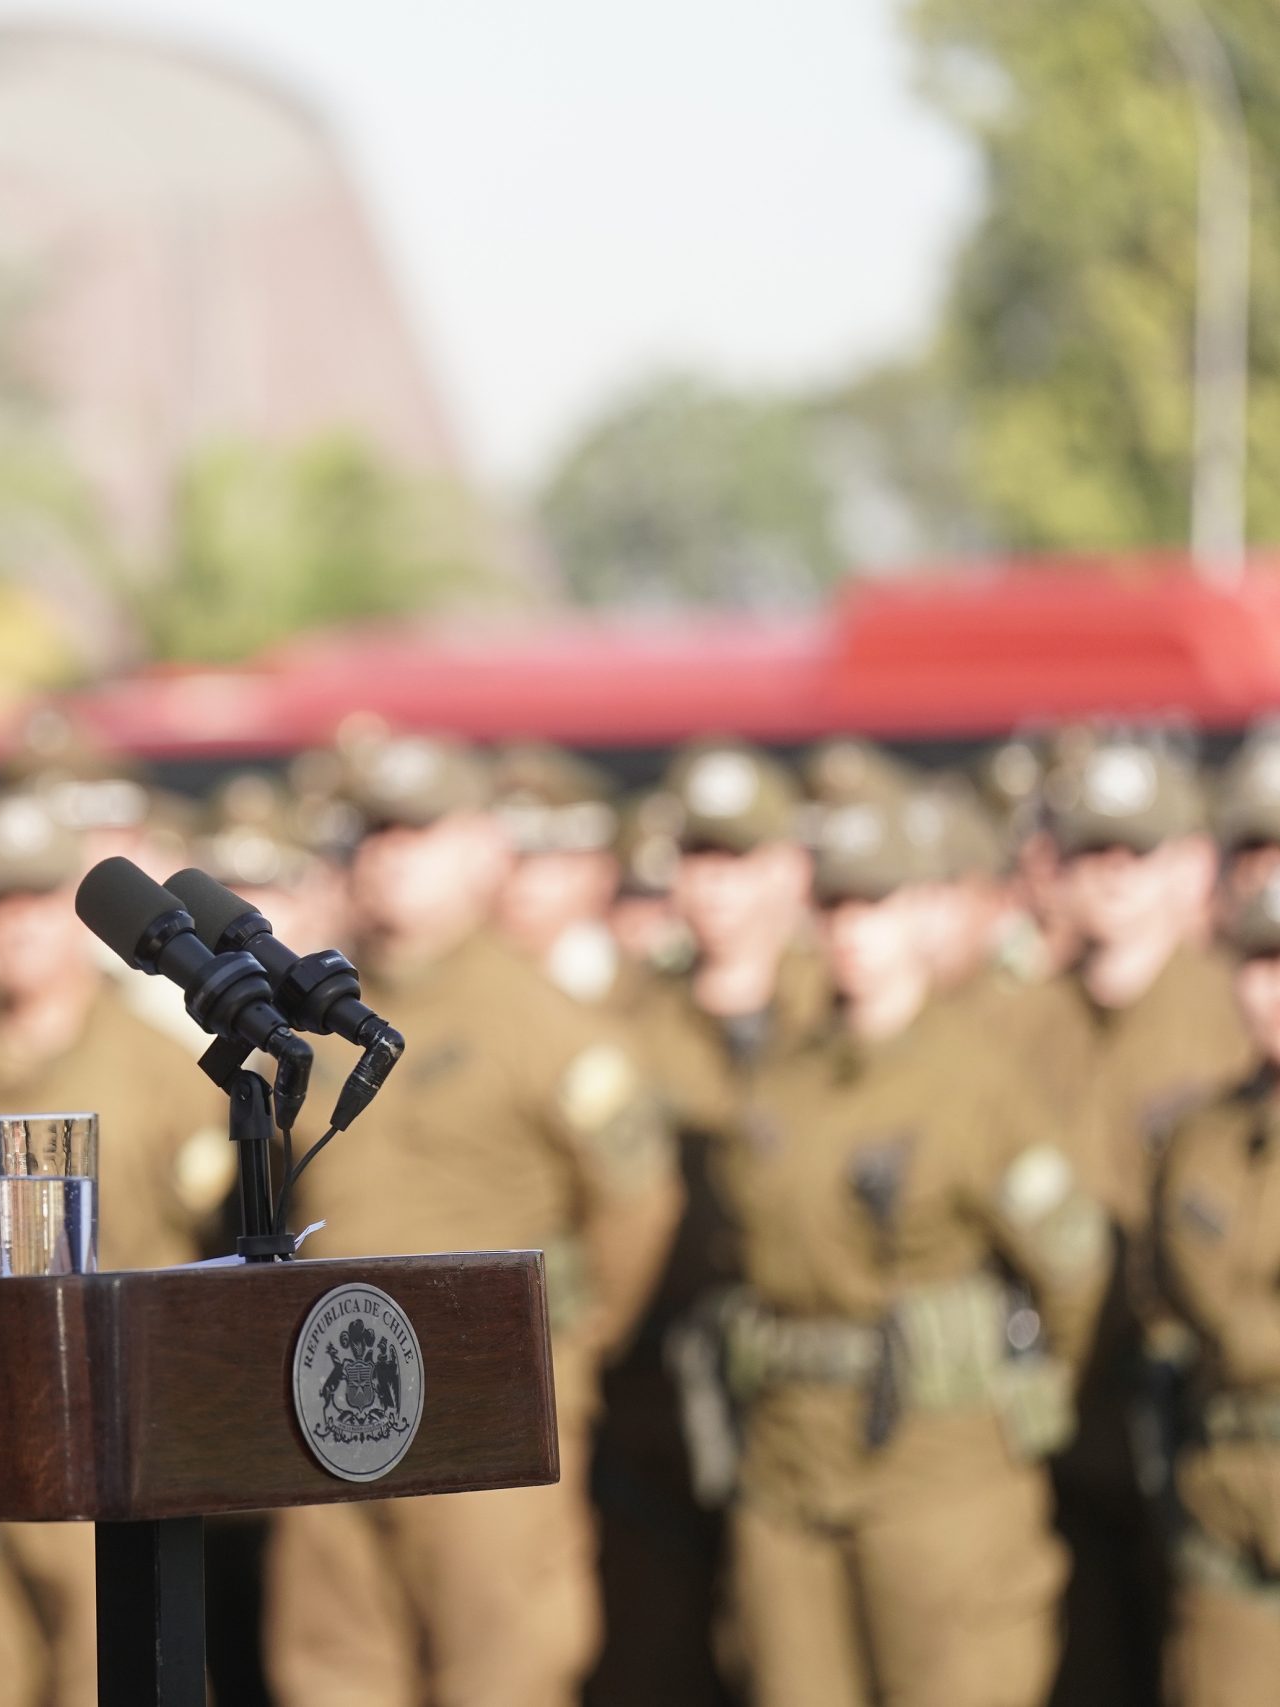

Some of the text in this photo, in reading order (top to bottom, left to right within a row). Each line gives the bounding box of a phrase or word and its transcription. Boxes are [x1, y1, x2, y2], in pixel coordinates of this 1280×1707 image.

[304, 1298, 414, 1369] REPUBLICA DE CHILE
